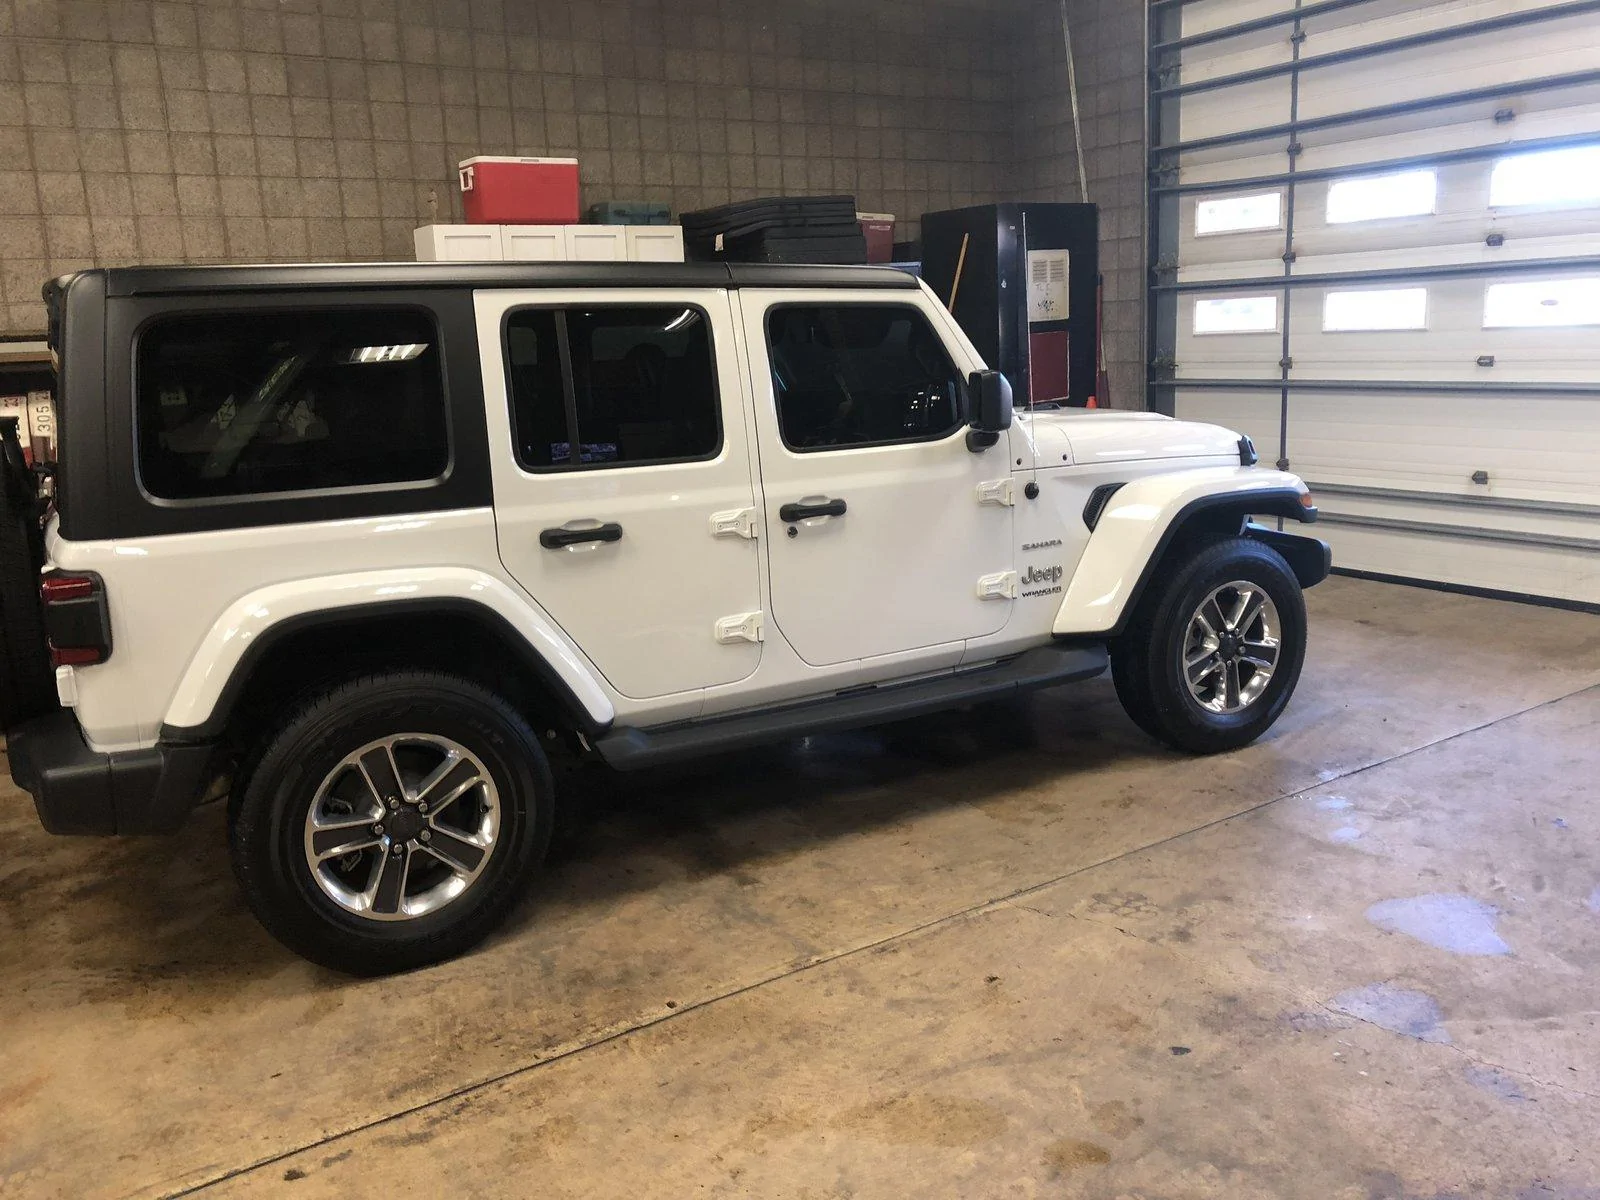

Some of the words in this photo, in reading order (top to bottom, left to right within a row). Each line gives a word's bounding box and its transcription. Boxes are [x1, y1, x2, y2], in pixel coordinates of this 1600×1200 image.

[36, 405, 51, 432] 305
[1021, 539, 1062, 551] SAHARA
[1021, 565, 1063, 585] Jeep
